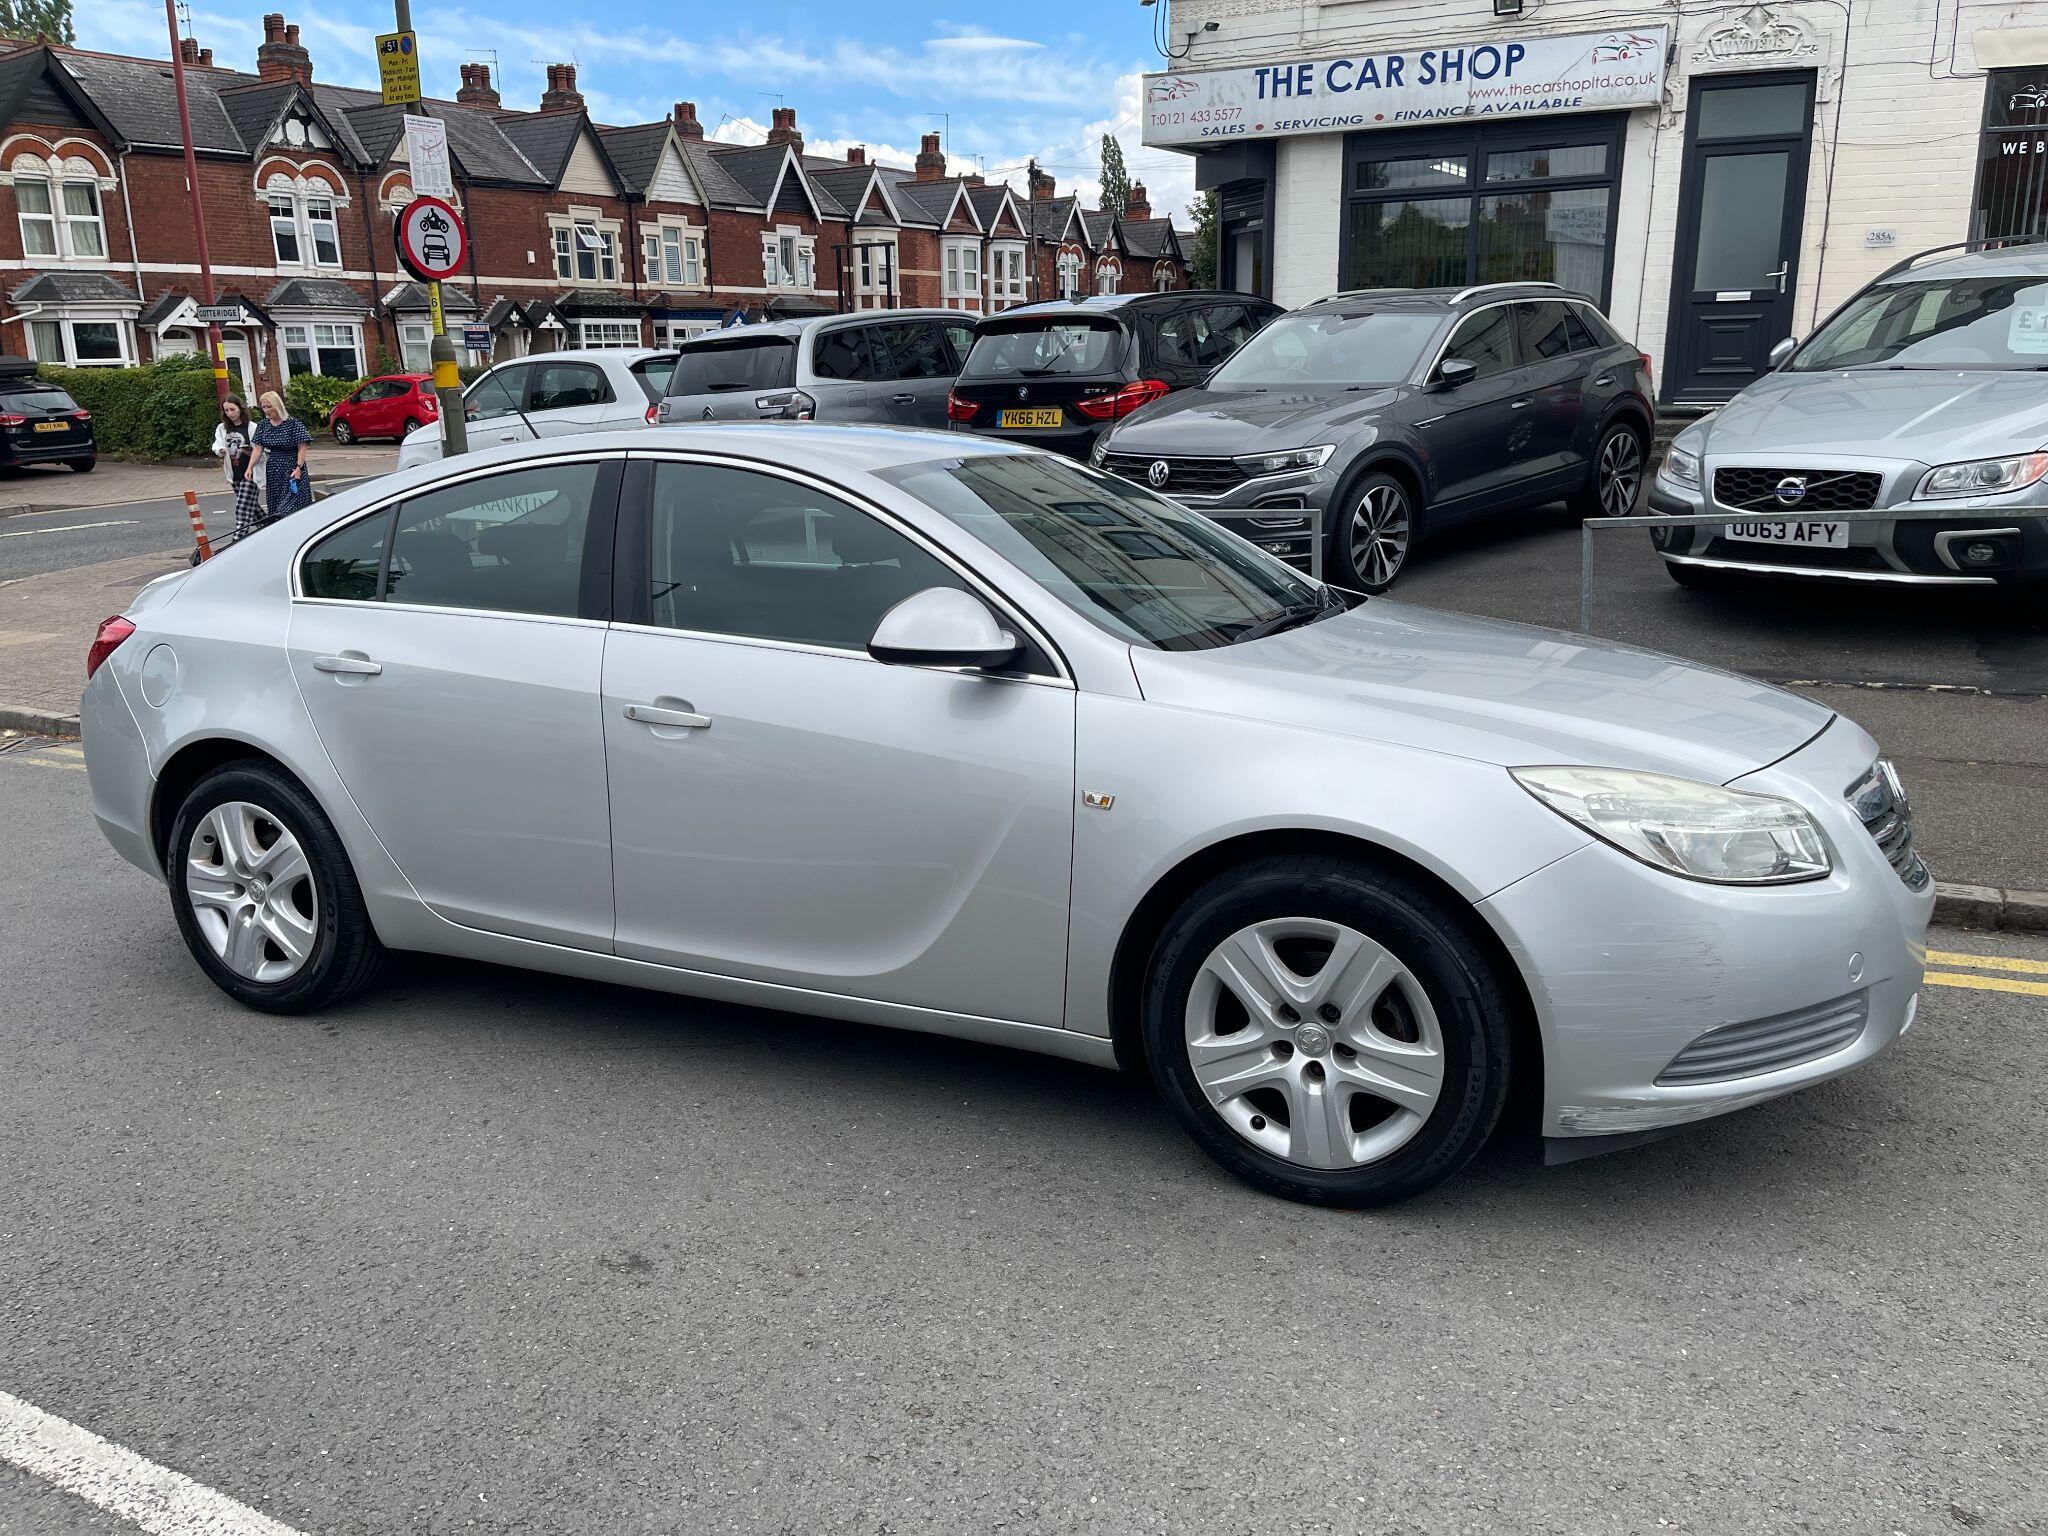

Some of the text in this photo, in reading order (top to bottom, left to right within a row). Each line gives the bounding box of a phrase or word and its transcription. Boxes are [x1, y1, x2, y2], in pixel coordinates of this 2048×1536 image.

[1255, 64, 1314, 99] THE
[1326, 55, 1405, 93] CAR
[1417, 43, 1525, 85] SHOP
[1468, 72, 1657, 99] www.thecarshopltd.co.uk
[1190, 109, 1211, 124] 433
[1213, 107, 1243, 122] 5577
[1200, 97, 1583, 137] SALES SERVICING FINANCE AVAILABLE
[2002, 141, 2028, 155] WE
[1869, 231, 1892, 241] 285A
[198, 309, 237, 317] COTTERIDGE
[1004, 411, 1059, 425] YK66 HZL
[1793, 521, 1838, 542] AFY
